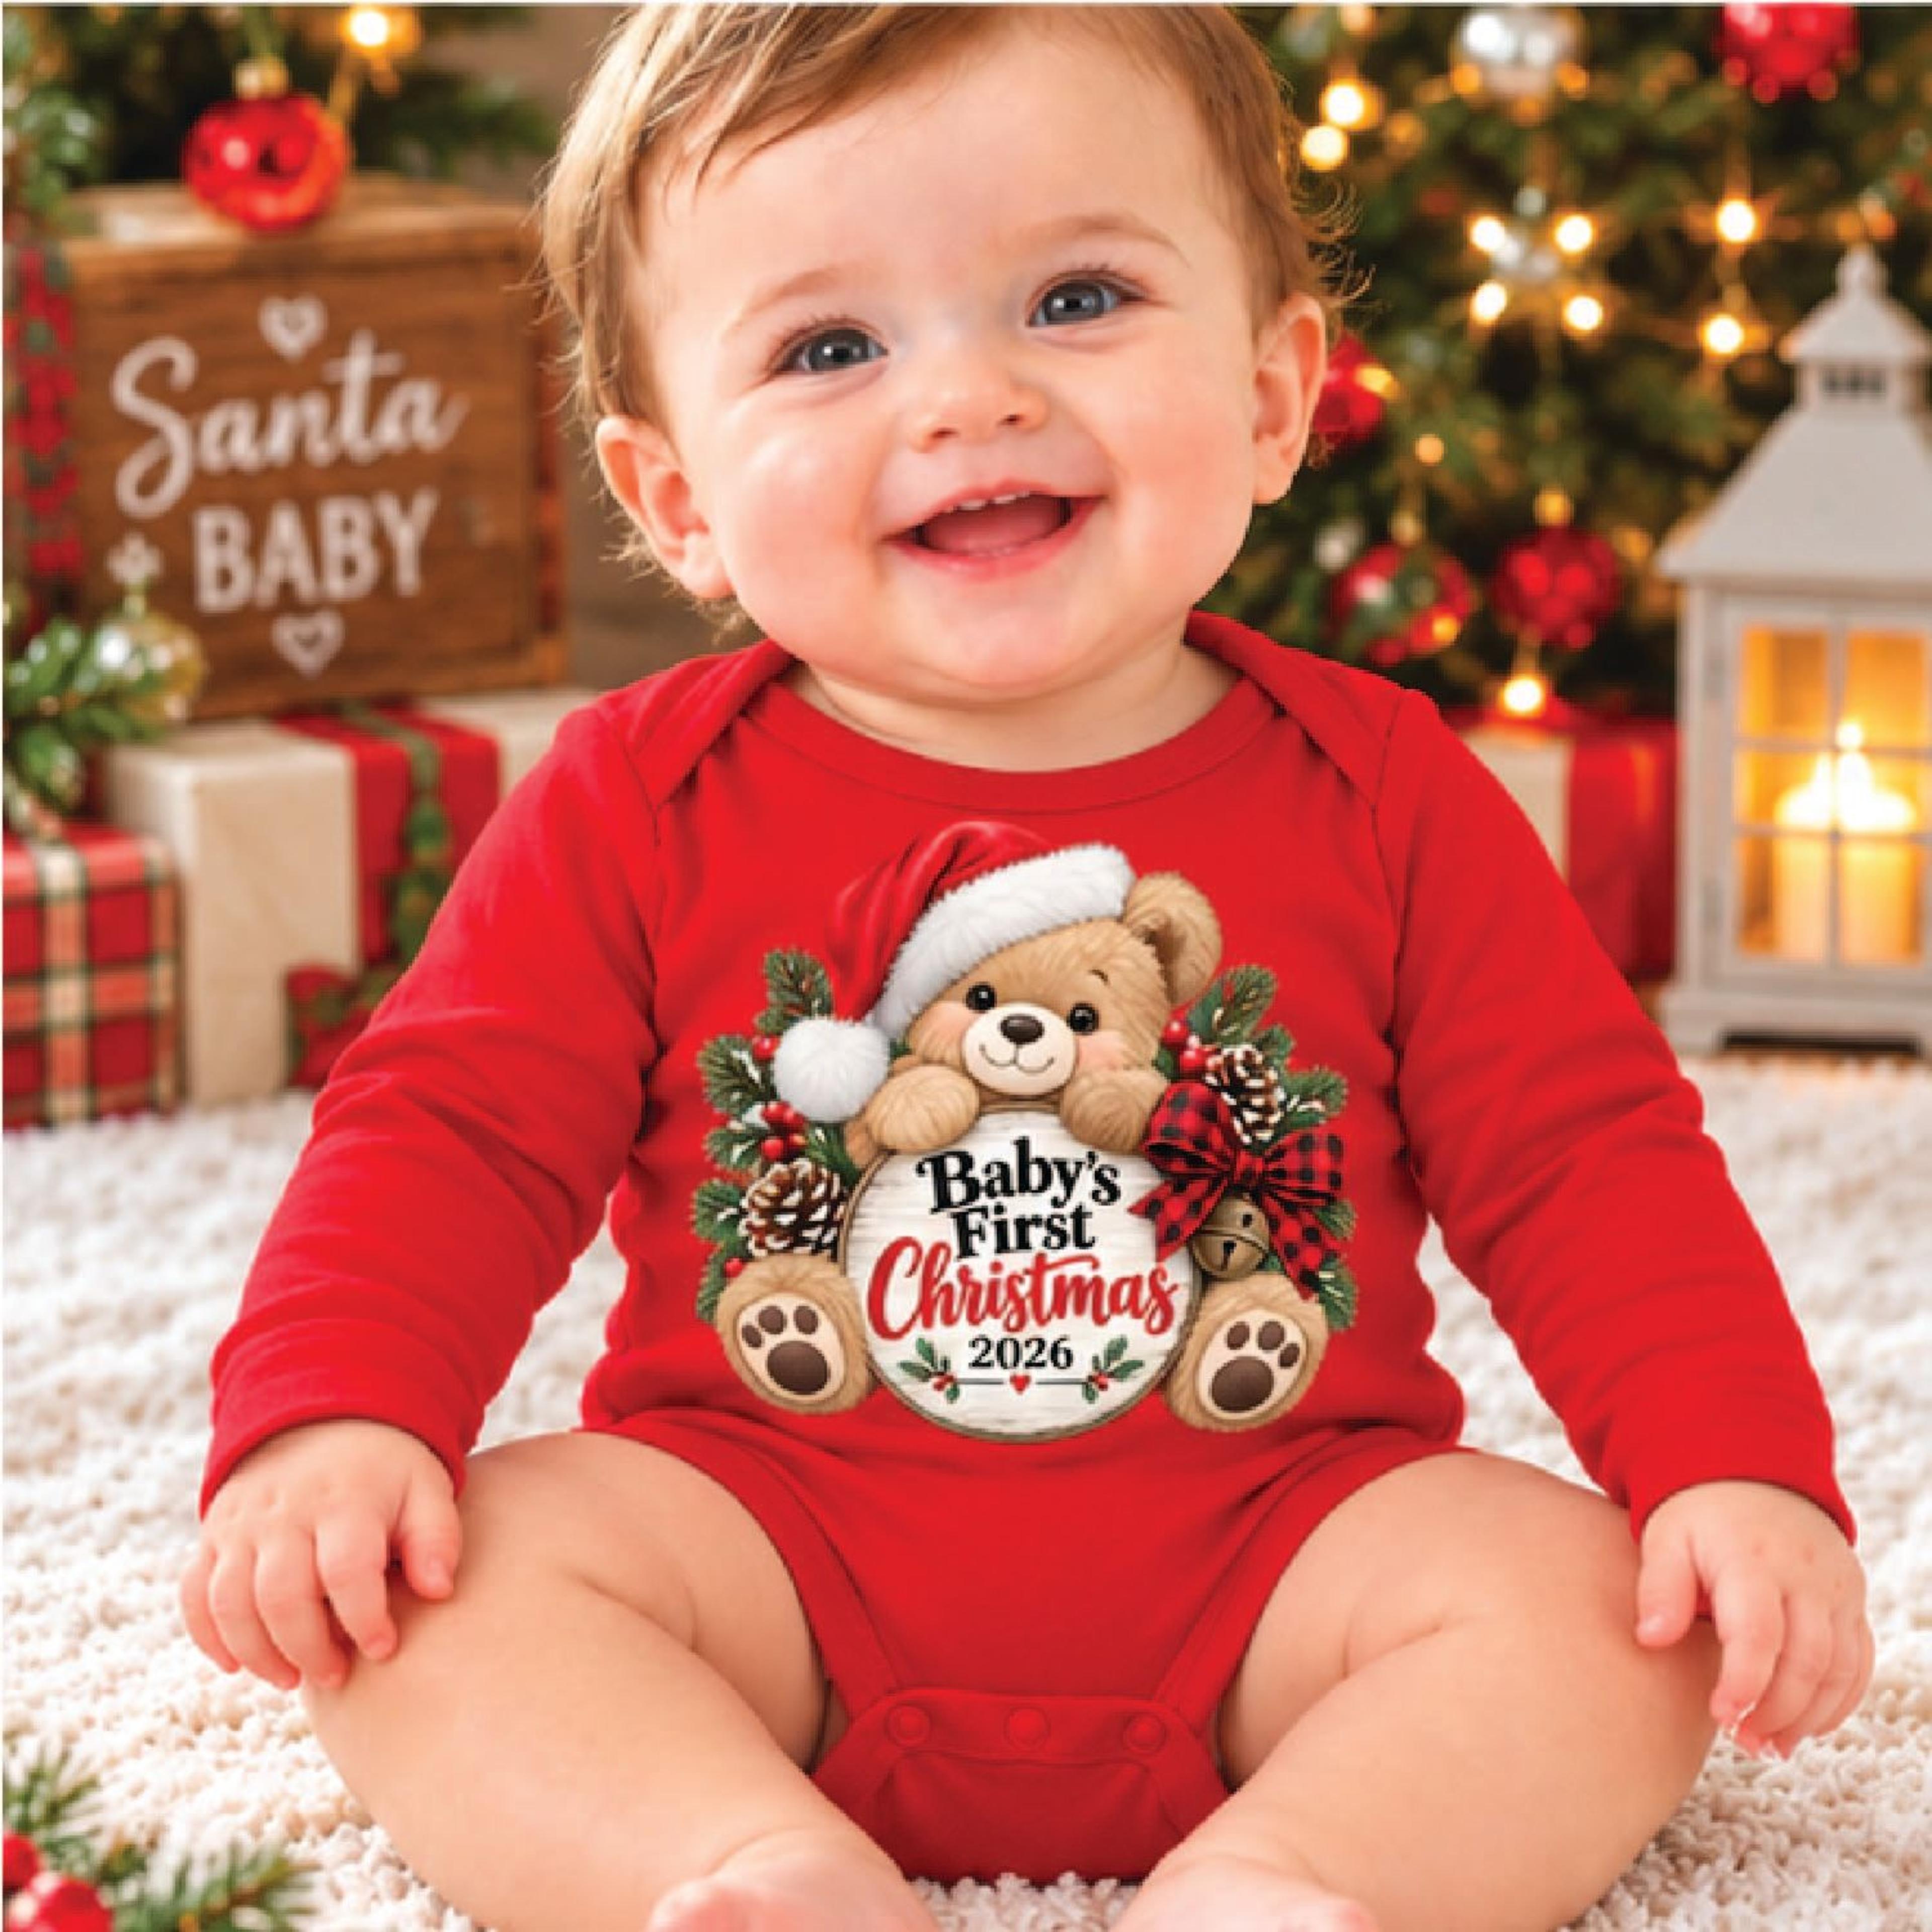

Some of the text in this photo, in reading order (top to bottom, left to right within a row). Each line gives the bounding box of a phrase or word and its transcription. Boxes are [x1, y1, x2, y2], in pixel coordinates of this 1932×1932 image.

[110, 328, 469, 518] Santa
[194, 487, 439, 612] BABY
[916, 1136, 1121, 1215] Baby's
[951, 1202, 1095, 1259] First
[867, 1237, 1178, 1340] Christmas
[969, 1335, 1074, 1369] 2026
